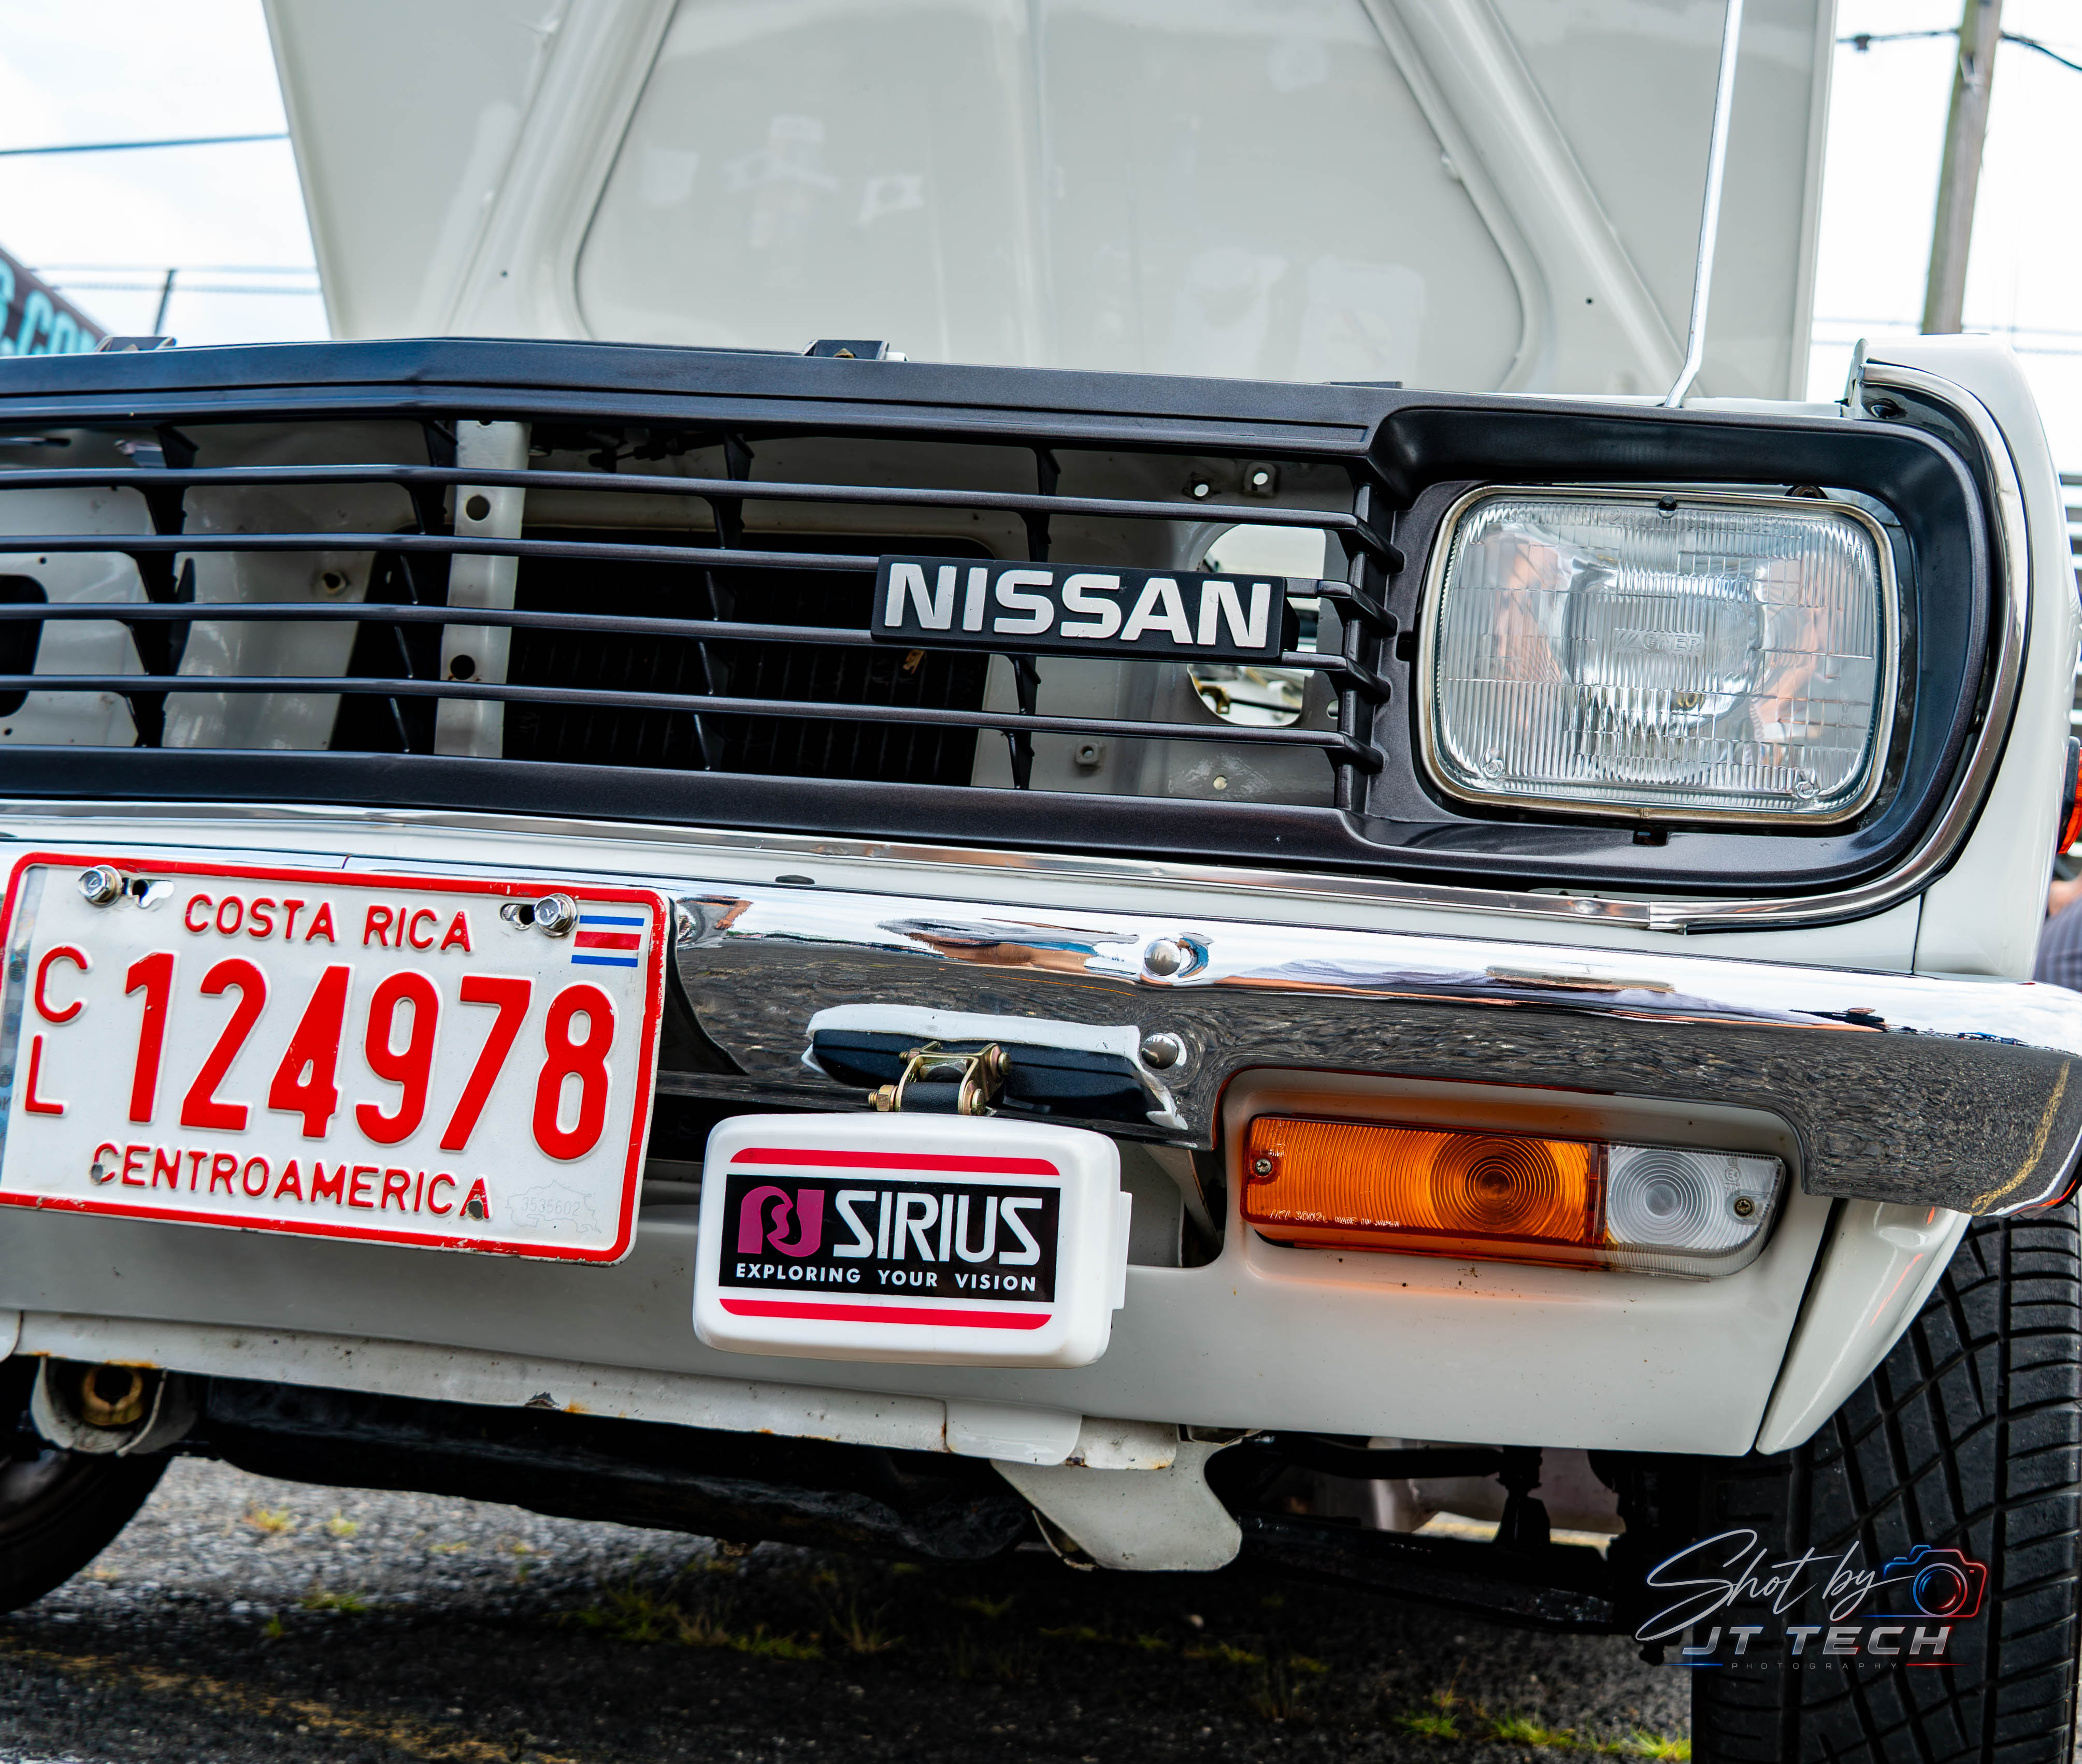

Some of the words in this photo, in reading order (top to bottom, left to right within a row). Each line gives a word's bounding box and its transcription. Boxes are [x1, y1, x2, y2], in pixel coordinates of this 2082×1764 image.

[885, 563, 1271, 648] NISSAN
[184, 893, 336, 943] COSTA
[363, 905, 472, 952] RICA
[124, 952, 615, 1161] 124978
[93, 1143, 490, 1220] CENTROAMERICA
[521, 1197, 581, 1216] 3535602
[834, 1189, 1042, 1265] SIRIUS
[1335, 1216, 1357, 1225] MADE
[736, 1263, 861, 1283] EXPLORING
[878, 1269, 938, 1287] YOUR
[955, 1273, 1036, 1292] VISION
